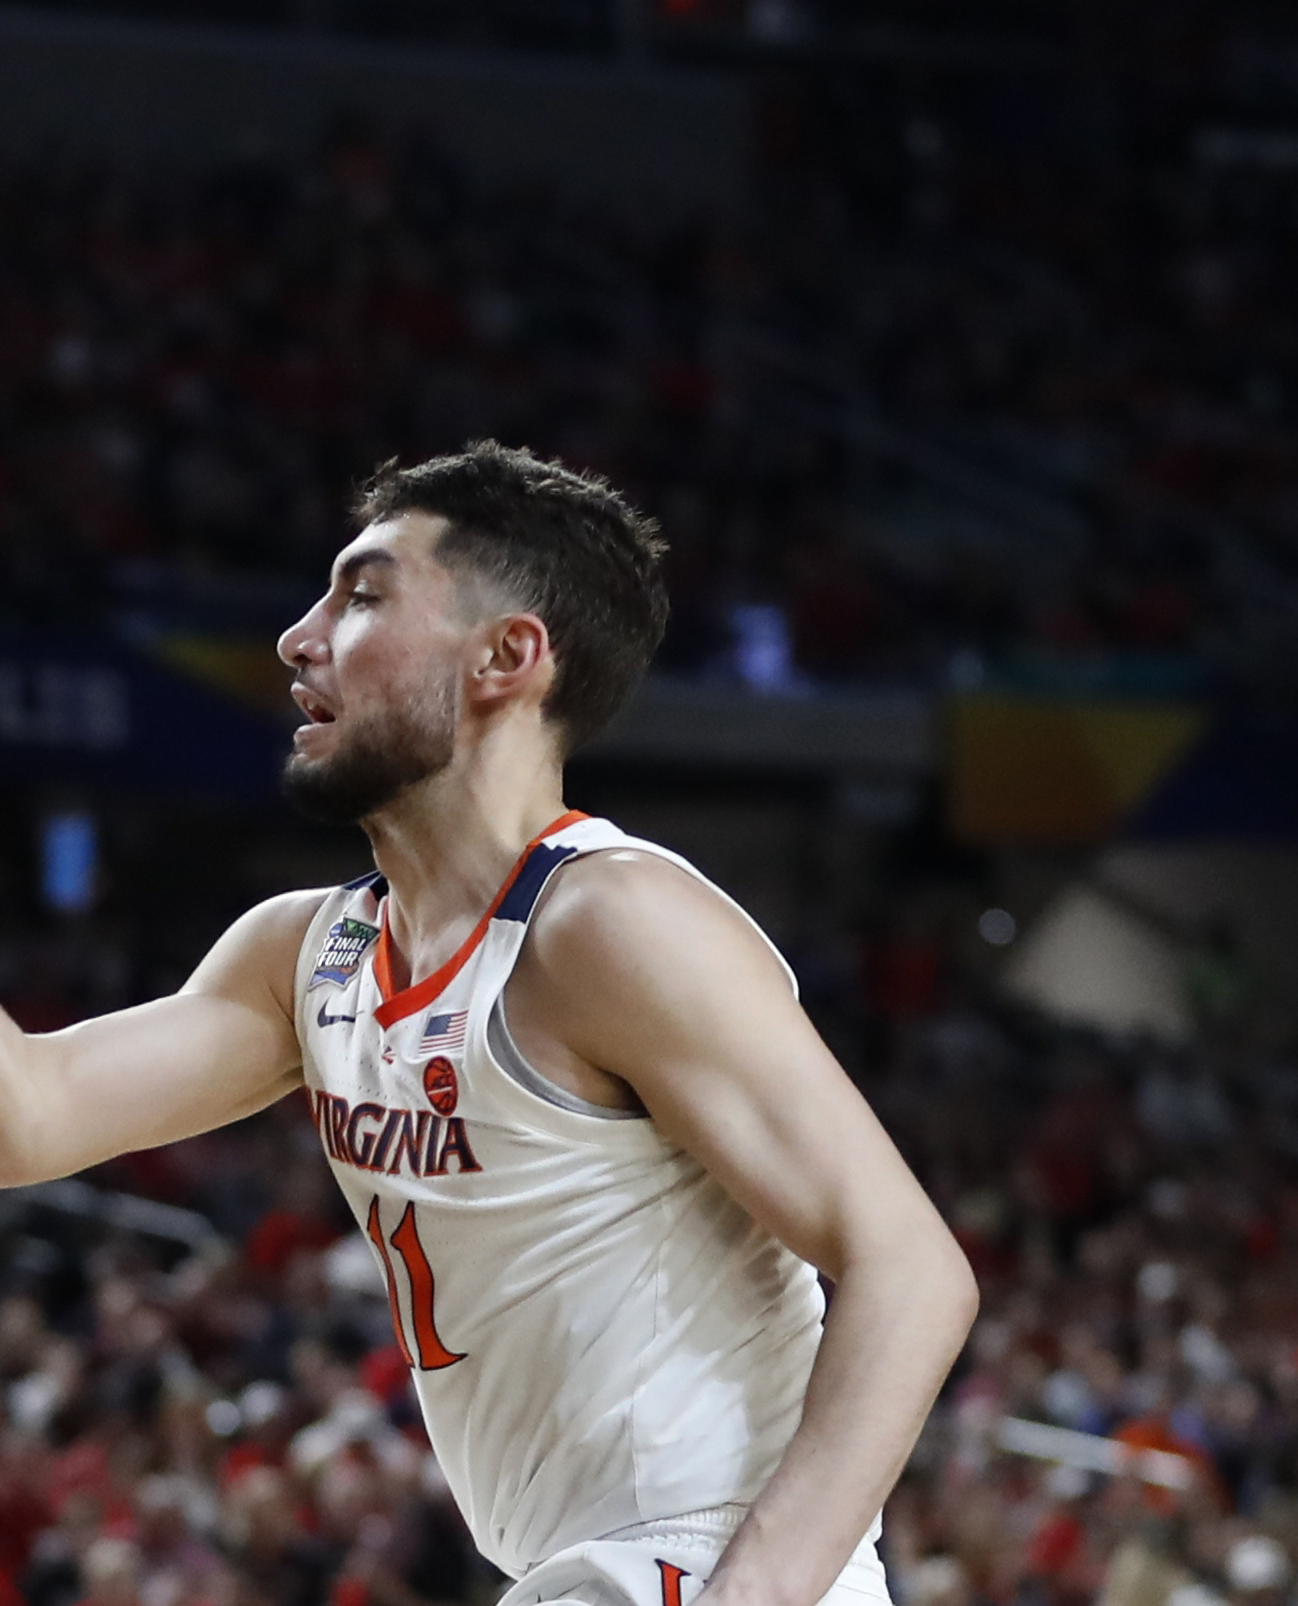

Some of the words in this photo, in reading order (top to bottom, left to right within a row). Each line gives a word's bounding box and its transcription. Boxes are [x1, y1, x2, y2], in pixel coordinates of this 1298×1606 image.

[317, 951, 359, 967] FOUR
[324, 936, 367, 951] FINAL
[305, 1086, 483, 1178] VIRGINIA
[366, 1193, 469, 1371] 11
